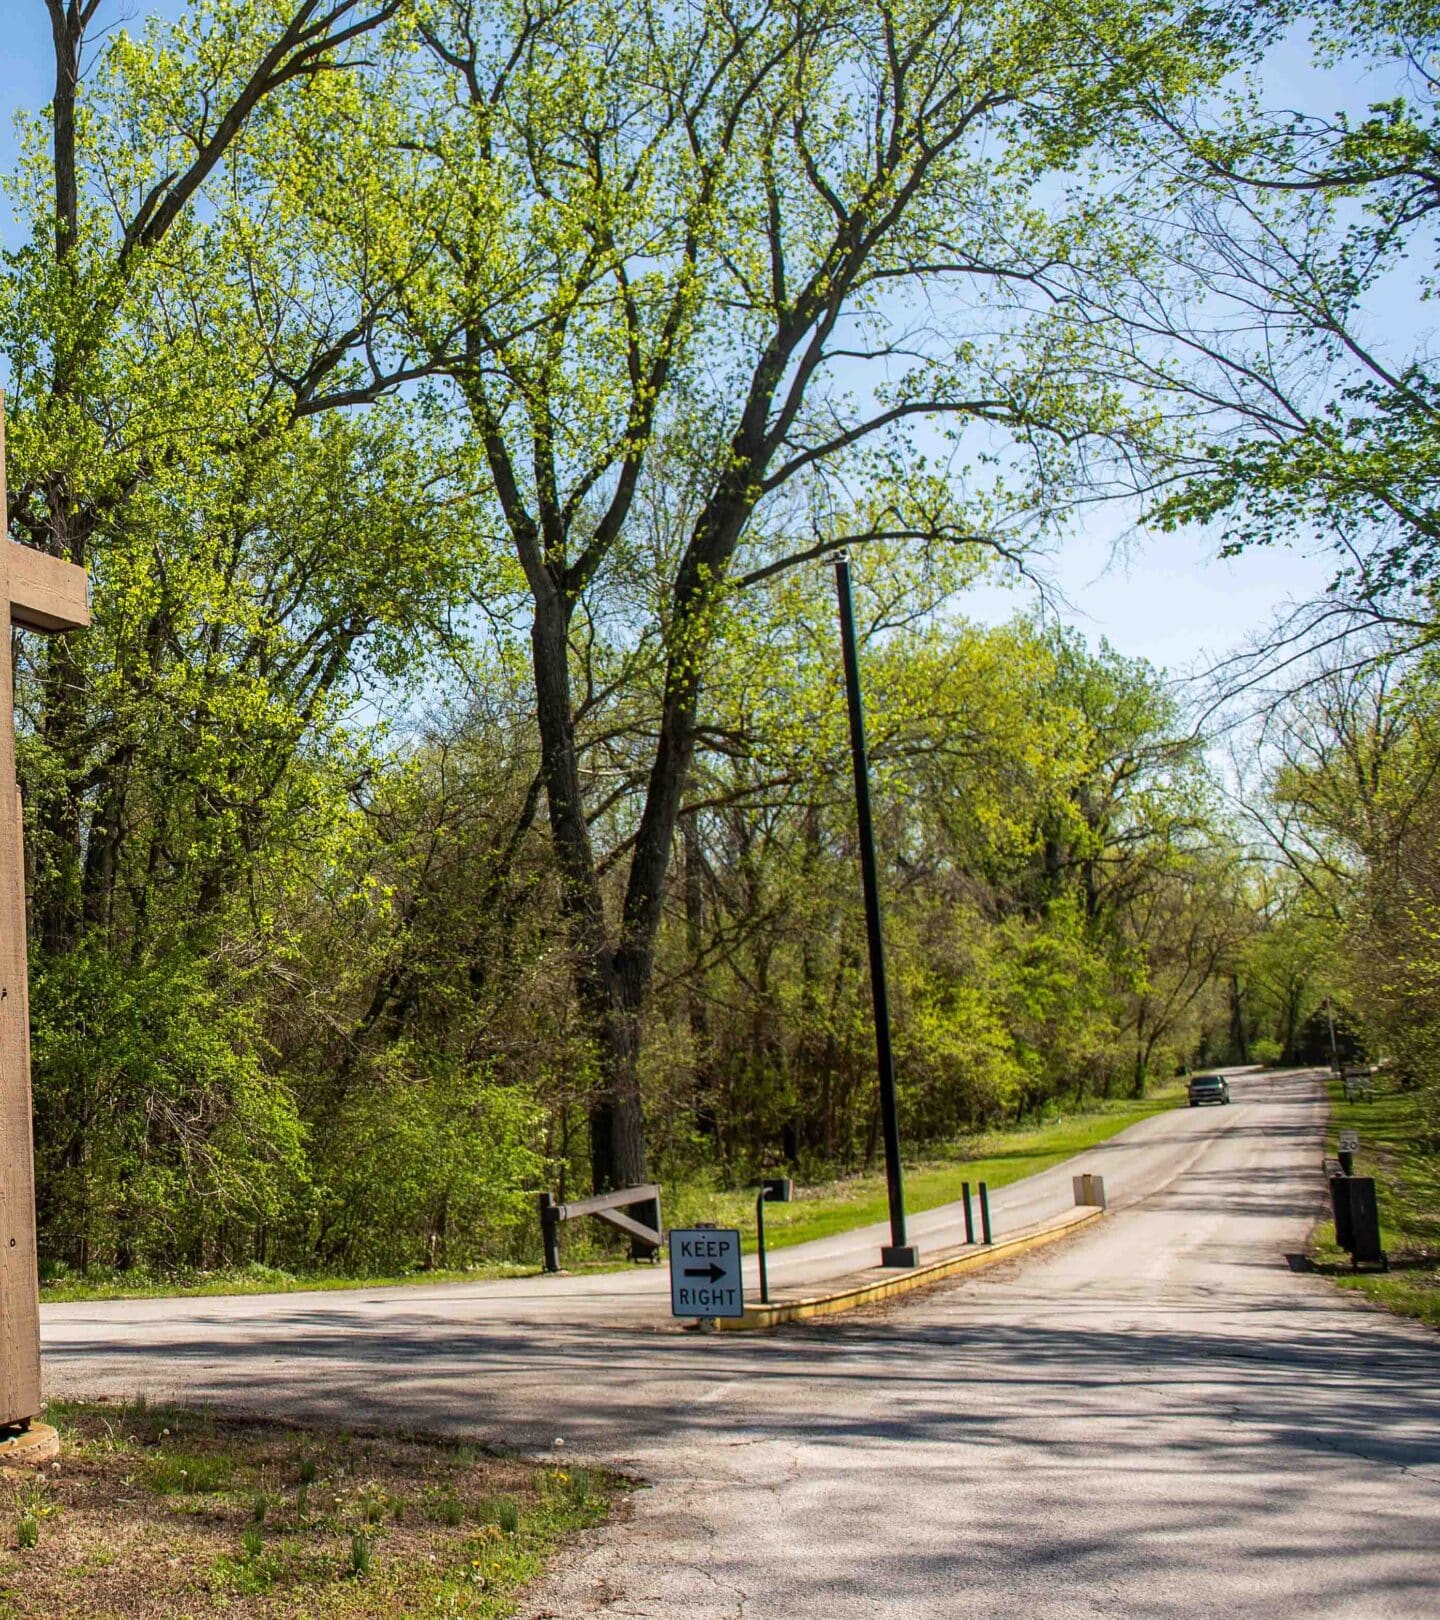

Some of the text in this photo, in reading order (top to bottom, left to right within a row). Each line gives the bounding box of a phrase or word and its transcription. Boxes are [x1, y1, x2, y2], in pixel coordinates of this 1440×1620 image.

[1340, 1141, 1357, 1150] 20
[681, 1241, 730, 1257] KEEP
[680, 1289, 735, 1306] RIGHT
